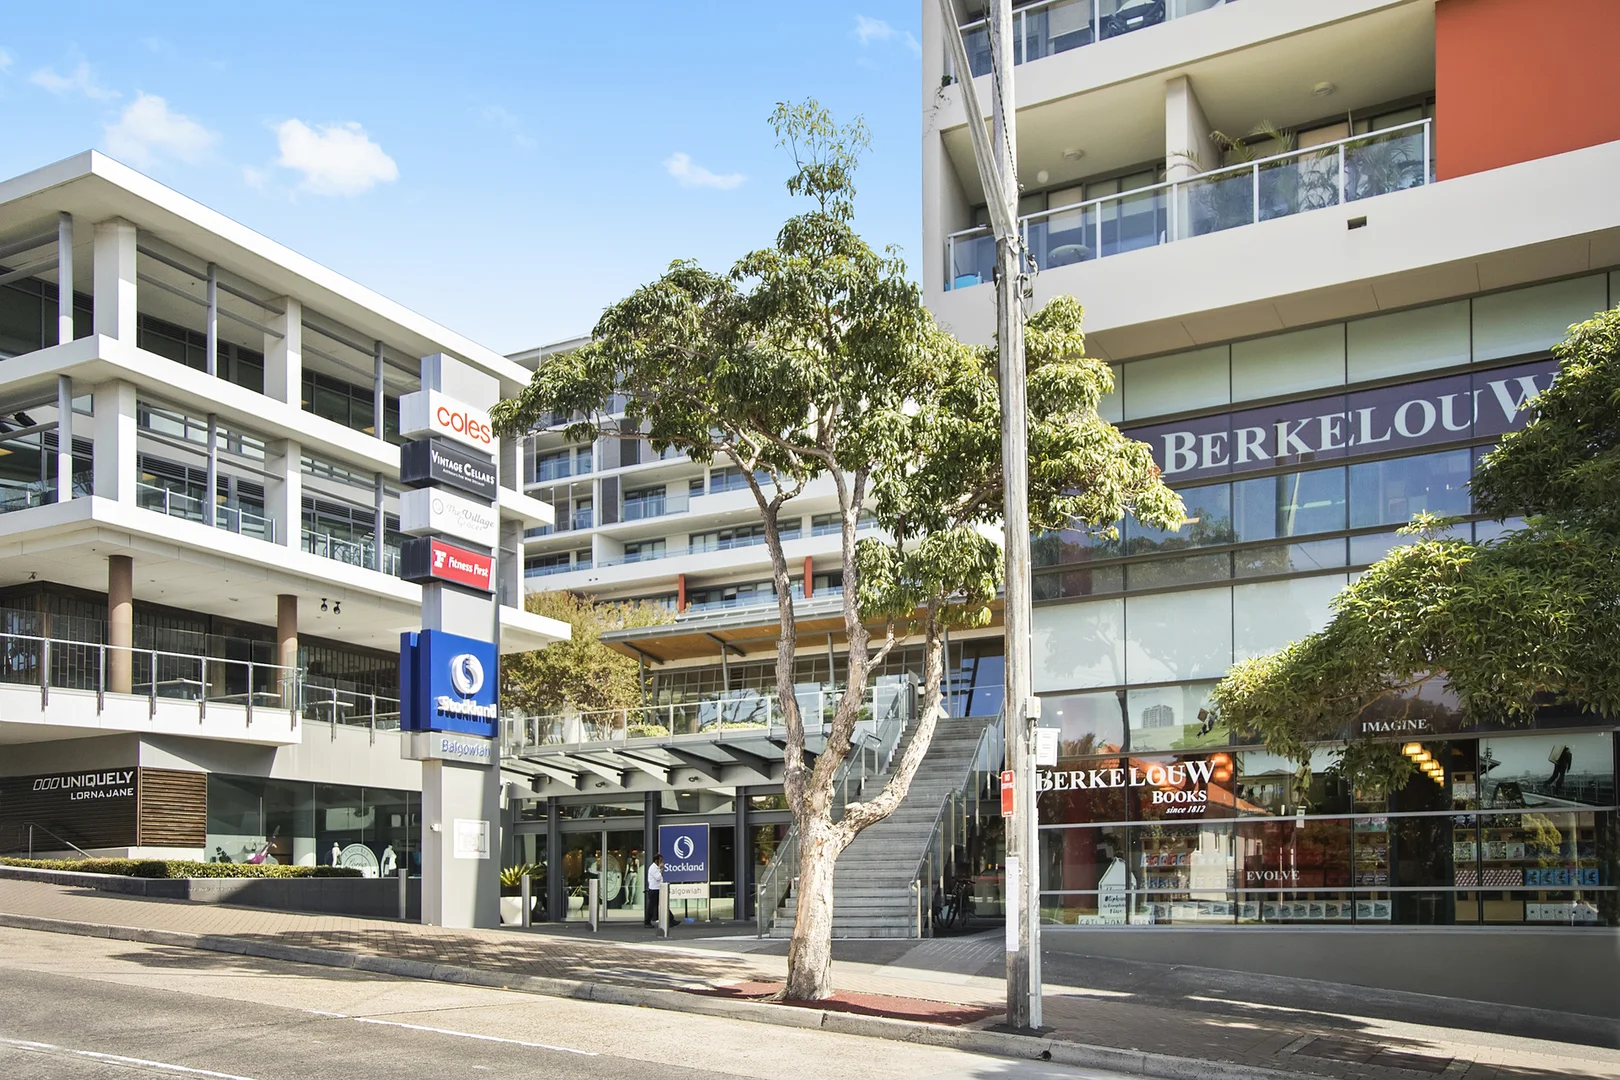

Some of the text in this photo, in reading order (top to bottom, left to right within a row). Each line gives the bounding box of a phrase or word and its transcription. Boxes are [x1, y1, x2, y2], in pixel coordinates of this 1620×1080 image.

[437, 406, 491, 444] coles
[1160, 371, 1562, 475] BERKELOUW
[431, 449, 463, 473] VINTAGE
[463, 463, 496, 485] CELLARS
[446, 503, 495, 529] The Village
[437, 696, 497, 718] Stockland
[1362, 718, 1427, 732] IMAGINE
[441, 739, 491, 757] Balgowlah
[61, 771, 134, 789] UNIQUELY
[1036, 759, 1217, 792] BERKELOUW
[70, 787, 134, 801] LORNA JANE
[1152, 790, 1207, 804] BOOKS
[1165, 805, 1206, 814] since 1812
[663, 862, 704, 872] Stockland
[1246, 870, 1300, 881] EVOLVE
[669, 887, 702, 896] algowlah
